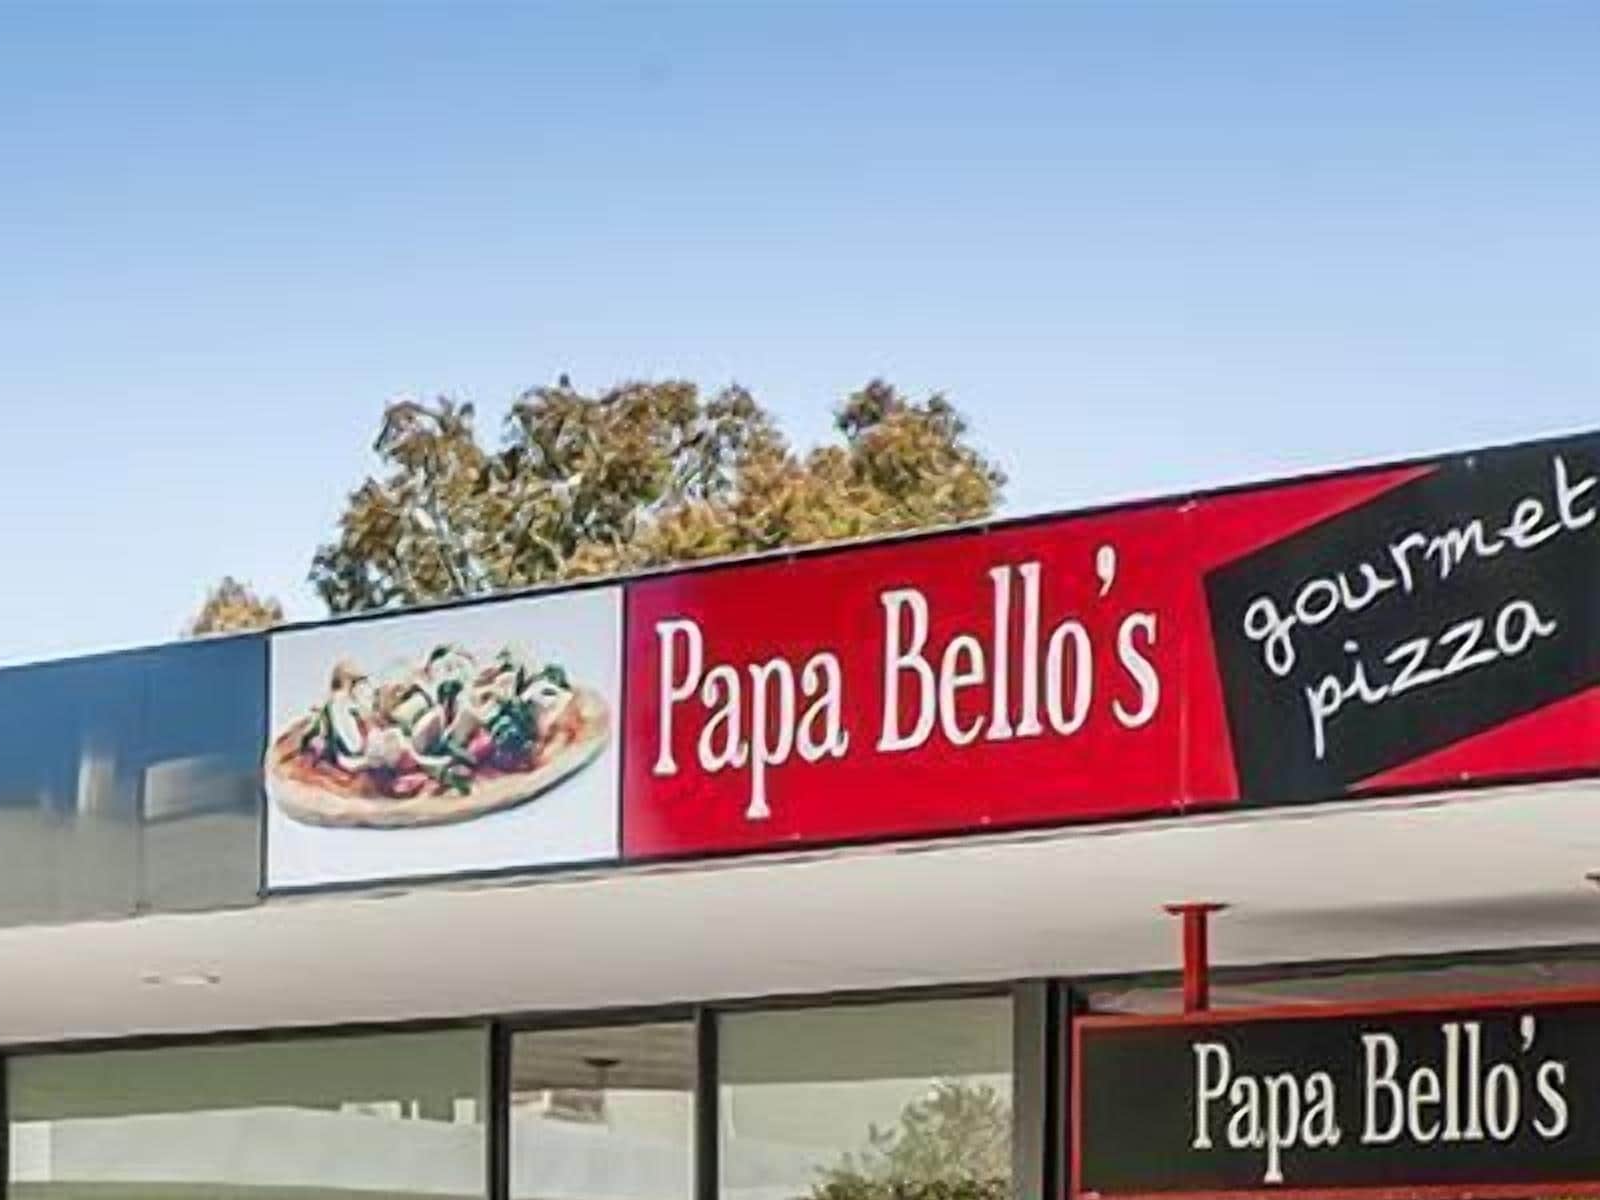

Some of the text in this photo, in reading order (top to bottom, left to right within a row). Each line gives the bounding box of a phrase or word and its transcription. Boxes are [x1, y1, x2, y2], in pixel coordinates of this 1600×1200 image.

[1244, 455, 1598, 676] gourmet
[652, 545, 1160, 819] Papa Bello's
[1306, 600, 1556, 759] pizza
[1192, 1015, 1569, 1183] Papa Bello's
